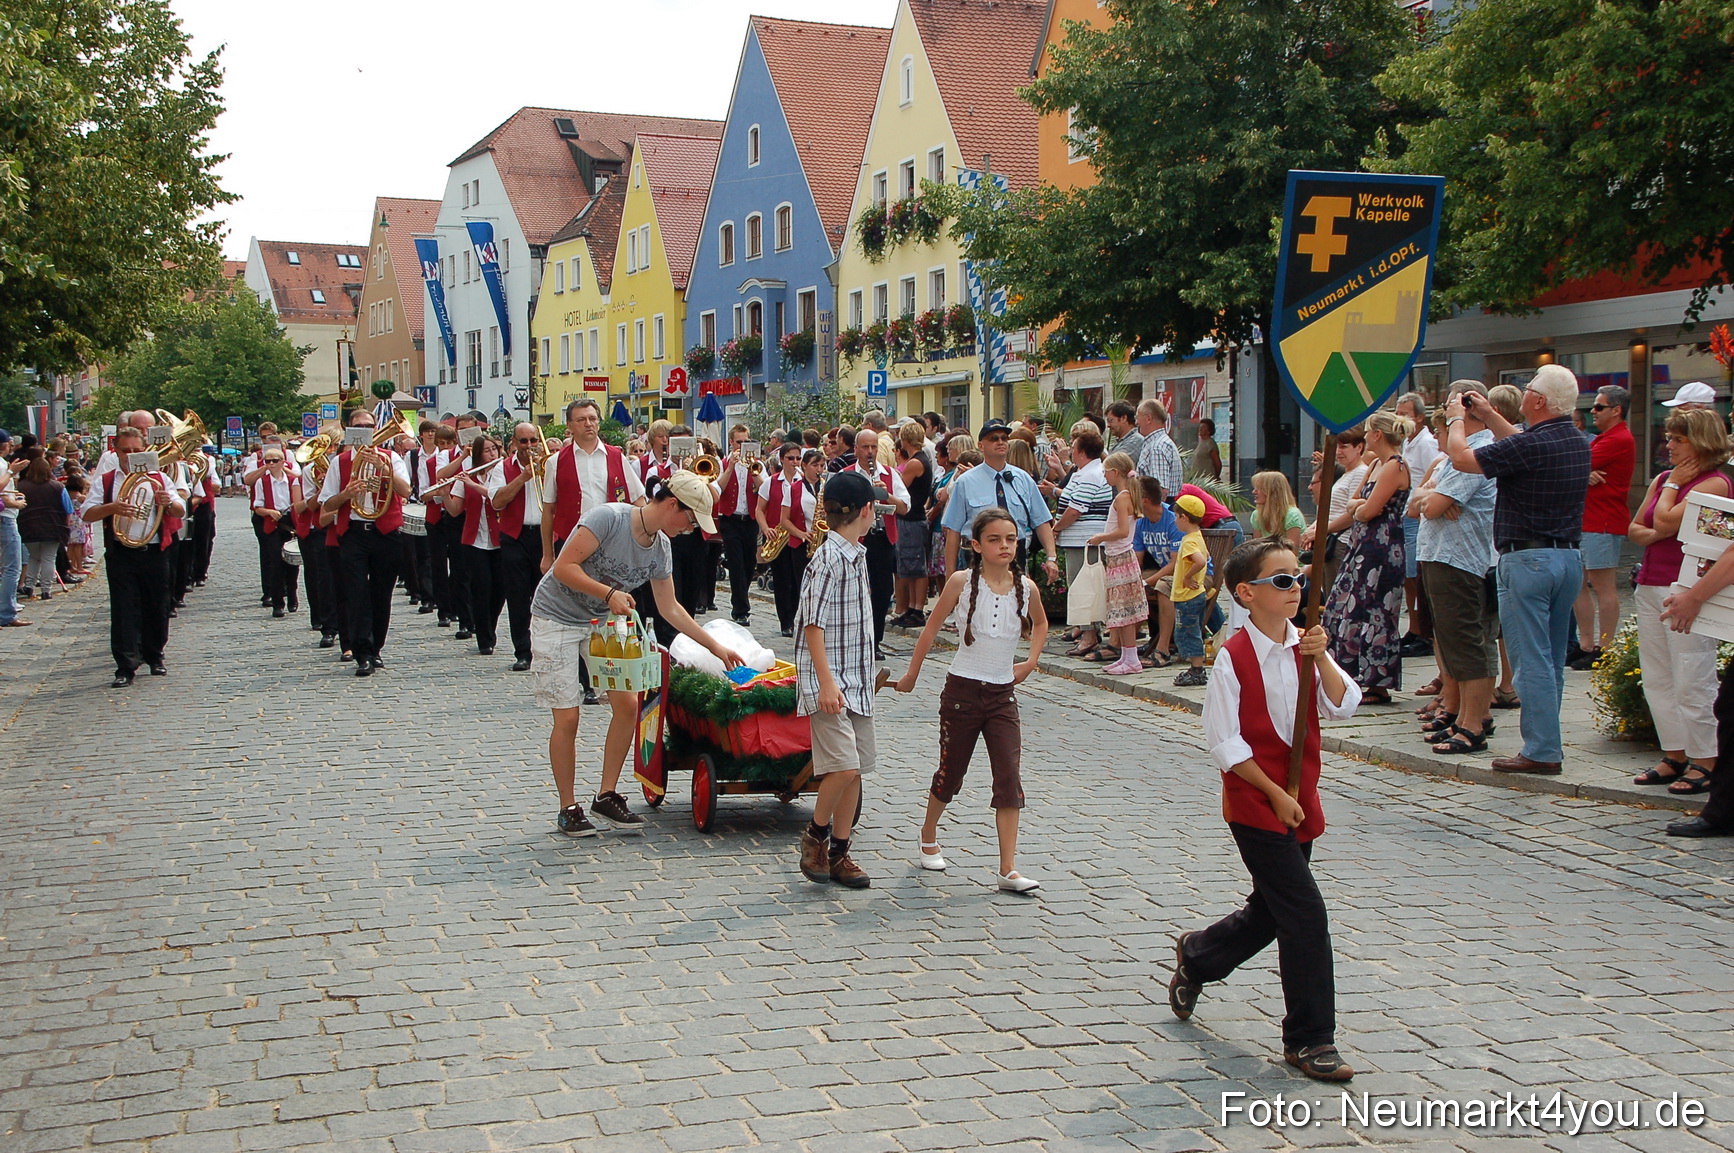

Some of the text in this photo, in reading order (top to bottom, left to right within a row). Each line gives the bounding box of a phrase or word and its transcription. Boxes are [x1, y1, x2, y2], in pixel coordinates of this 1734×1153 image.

[1358, 193, 1424, 208] Werkvolk
[1355, 207, 1410, 223] Kapelle
[1297, 242, 1420, 321] Neumarkt i.d.OPf.
[564, 310, 582, 328] HOTEL
[872, 373, 883, 394] P
